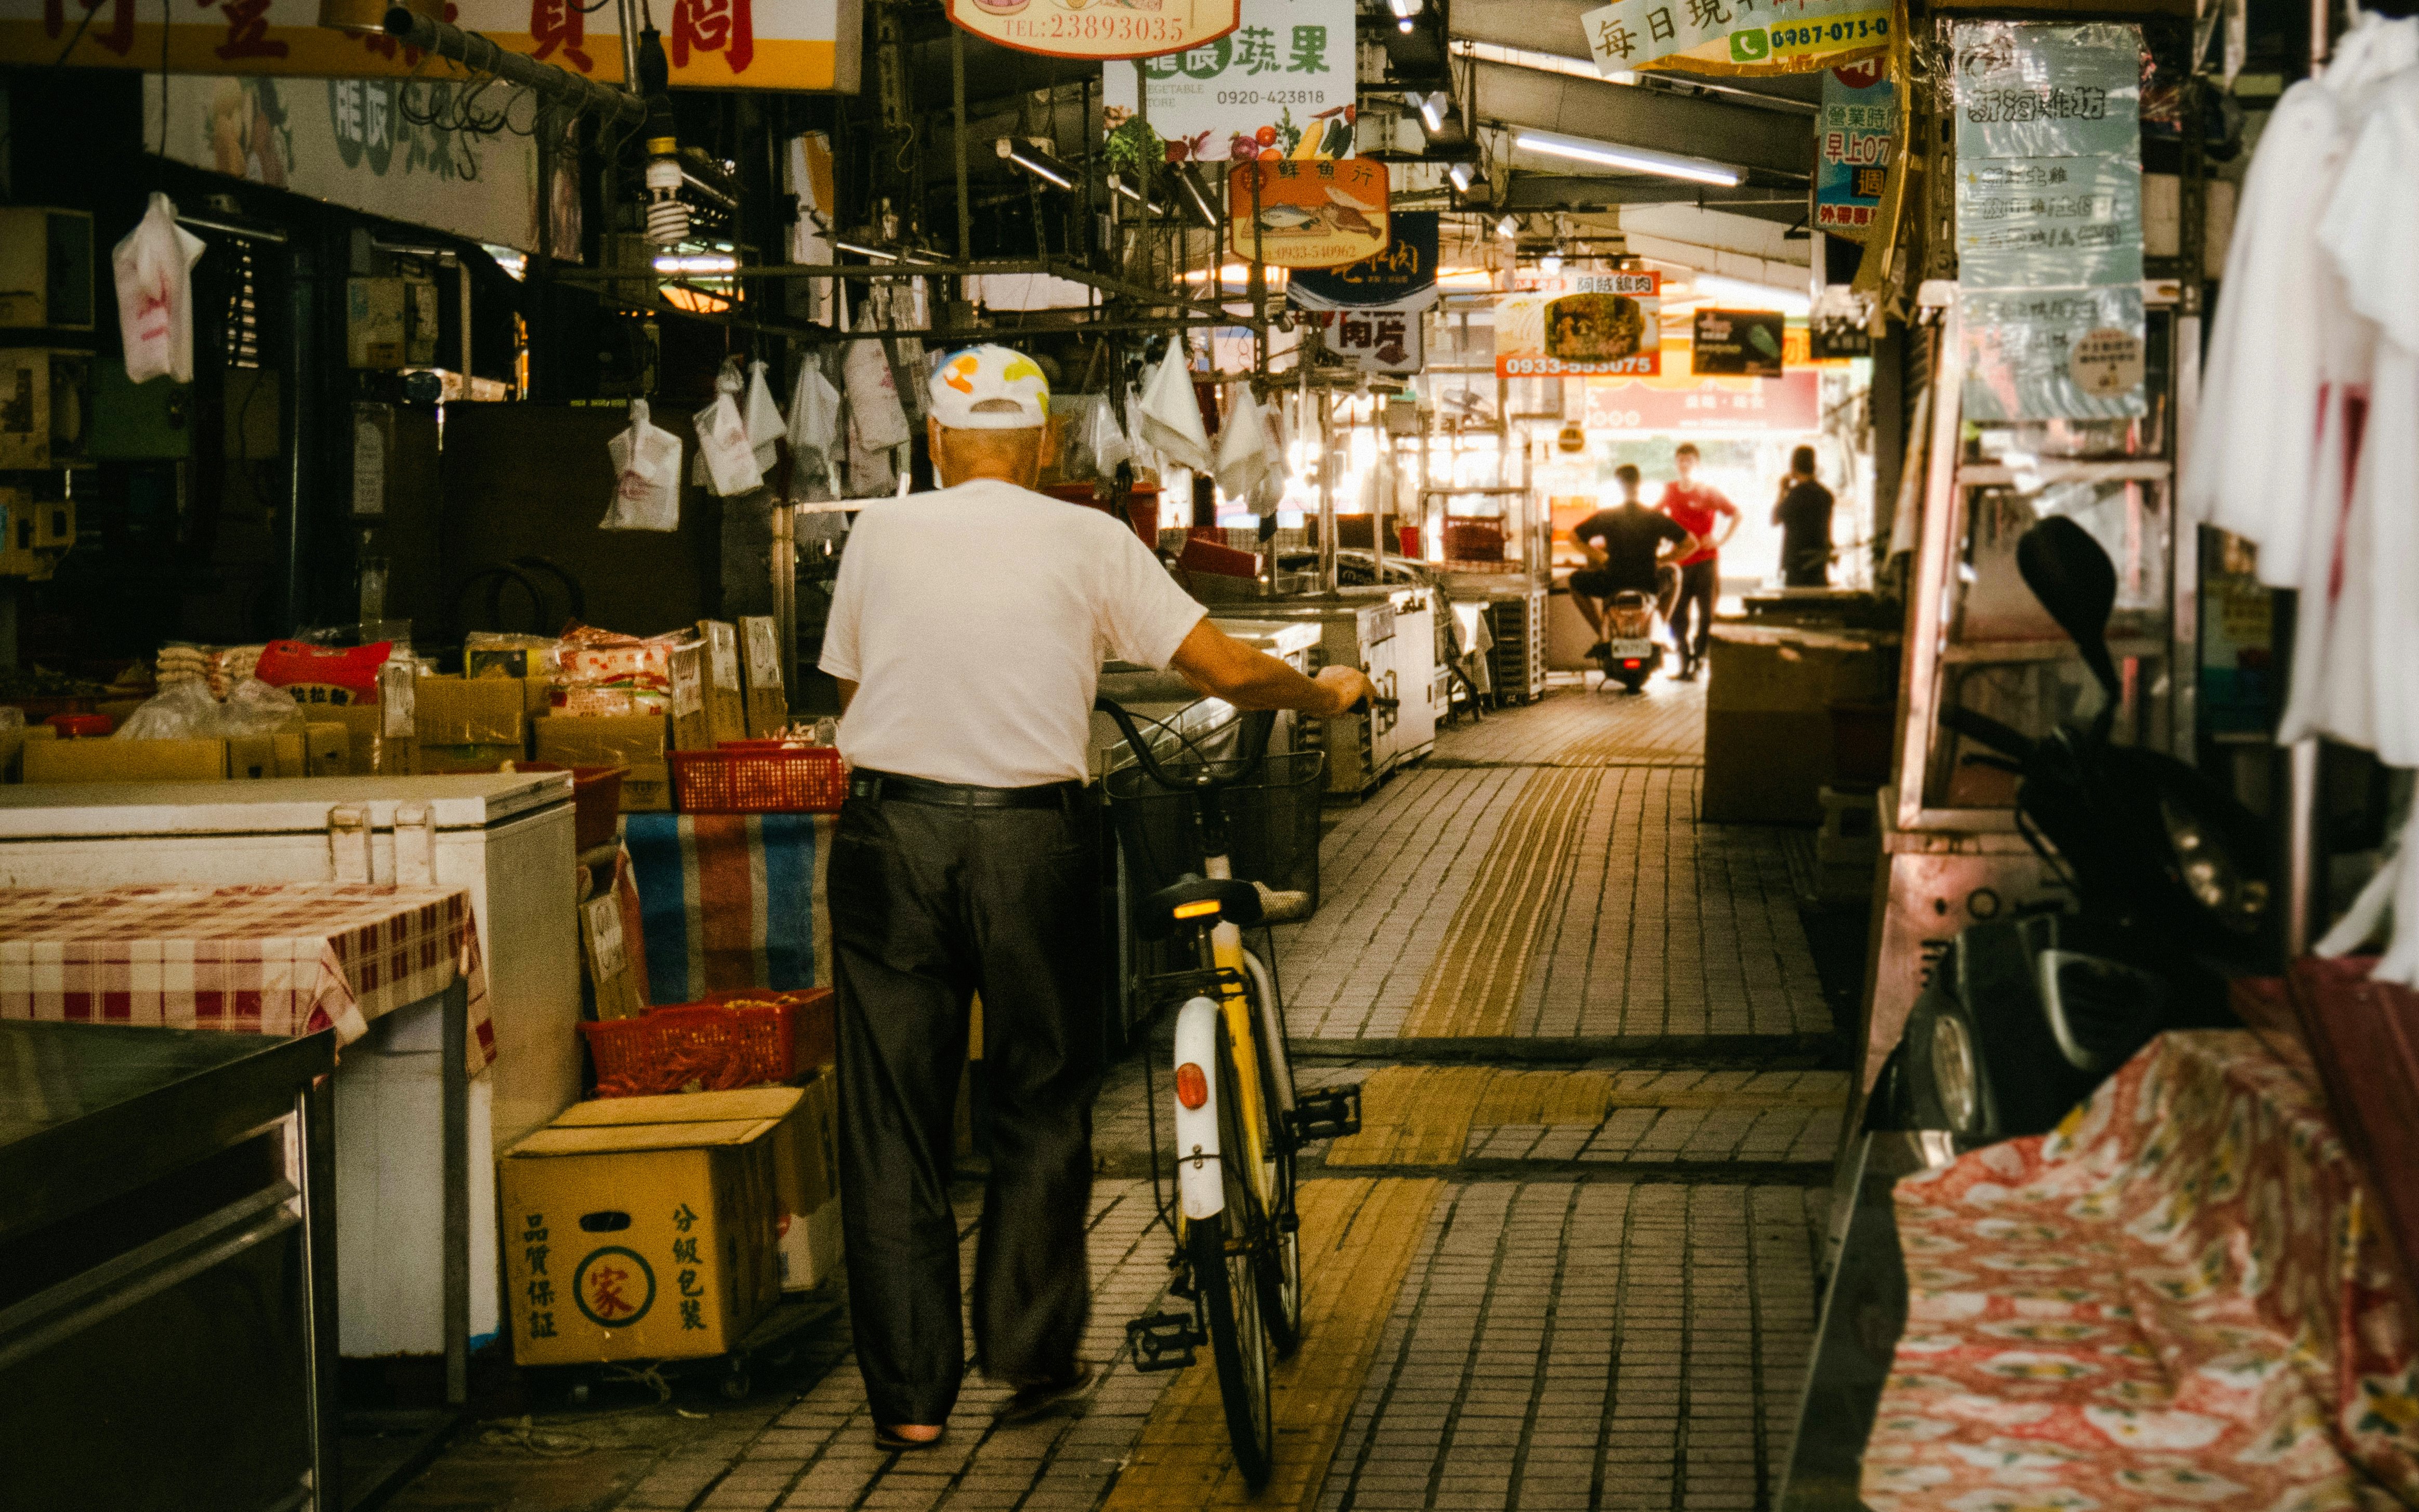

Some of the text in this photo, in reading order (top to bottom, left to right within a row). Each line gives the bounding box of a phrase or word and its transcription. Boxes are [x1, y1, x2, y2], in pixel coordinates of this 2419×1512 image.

[1003, 17, 1184, 43] TEL:23893035
[1147, 84, 1204, 95] EGETABLE
[1147, 98, 1176, 108] TORE
[1218, 90, 1325, 105] 0920-423818
[590, 1265, 634, 1317] 家
